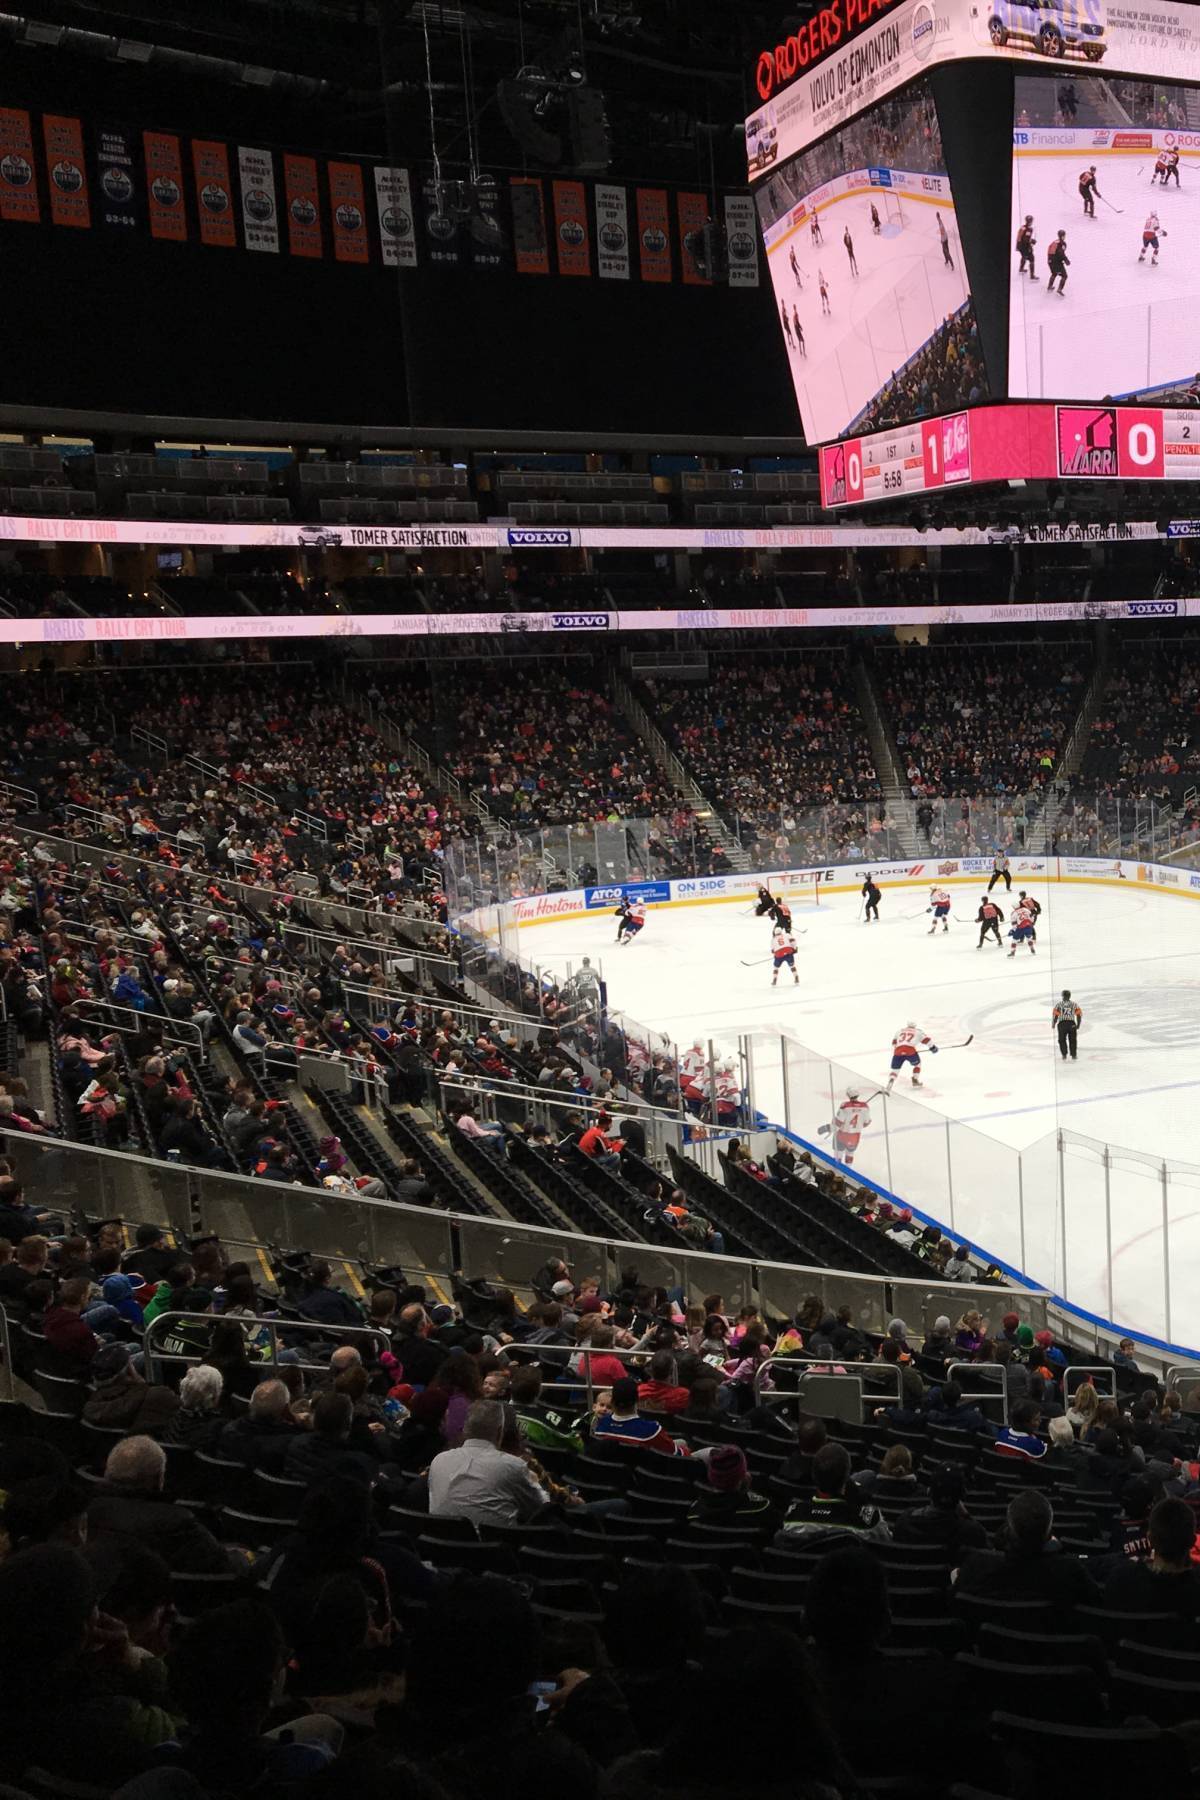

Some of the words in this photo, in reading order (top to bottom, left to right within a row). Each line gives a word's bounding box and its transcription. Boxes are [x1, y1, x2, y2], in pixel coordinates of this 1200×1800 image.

[774, 1, 842, 84] ROGERS
[809, 67, 836, 113] VOLVO
[837, 61, 848, 93] OF
[849, 22, 900, 86] EDMONTON
[1031, 132, 1076, 145] Financial
[925, 177, 942, 193] ELITE
[1182, 427, 1190, 439] 2
[1128, 422, 1156, 466] 0
[886, 445, 897, 459] 1ST
[927, 434, 939, 475] 1
[848, 453, 861, 491] 0
[884, 470, 902, 488] 5:58
[27, 522, 59, 539] RALLY
[63, 523, 85, 539] CRY
[88, 524, 118, 540] TOUR
[350, 529, 388, 545] TOMER
[391, 529, 471, 546] SATISFACTION.
[510, 532, 570, 543] VOLVO
[756, 530, 784, 545] RALLY
[787, 531, 804, 545] CRY
[808, 530, 833, 545] TOUR
[990, 607, 1022, 618] JANUARY
[1127, 603, 1175, 614] VOLVO
[551, 615, 608, 627] VOLVO
[730, 611, 762, 626] RALLY
[763, 611, 779, 625] CRY
[782, 611, 808, 624] TOUR
[96, 620, 129, 640] RALLY
[134, 620, 155, 639] CRY
[158, 619, 186, 638] TOUR
[789, 870, 835, 885] ELITE
[678, 882, 697, 892] ON
[700, 879, 726, 889] SIDE
[590, 887, 623, 900] ATCO
[512, 902, 535, 920] Tim
[536, 897, 583, 915] Hortons
[899, 1032, 914, 1043] 37
